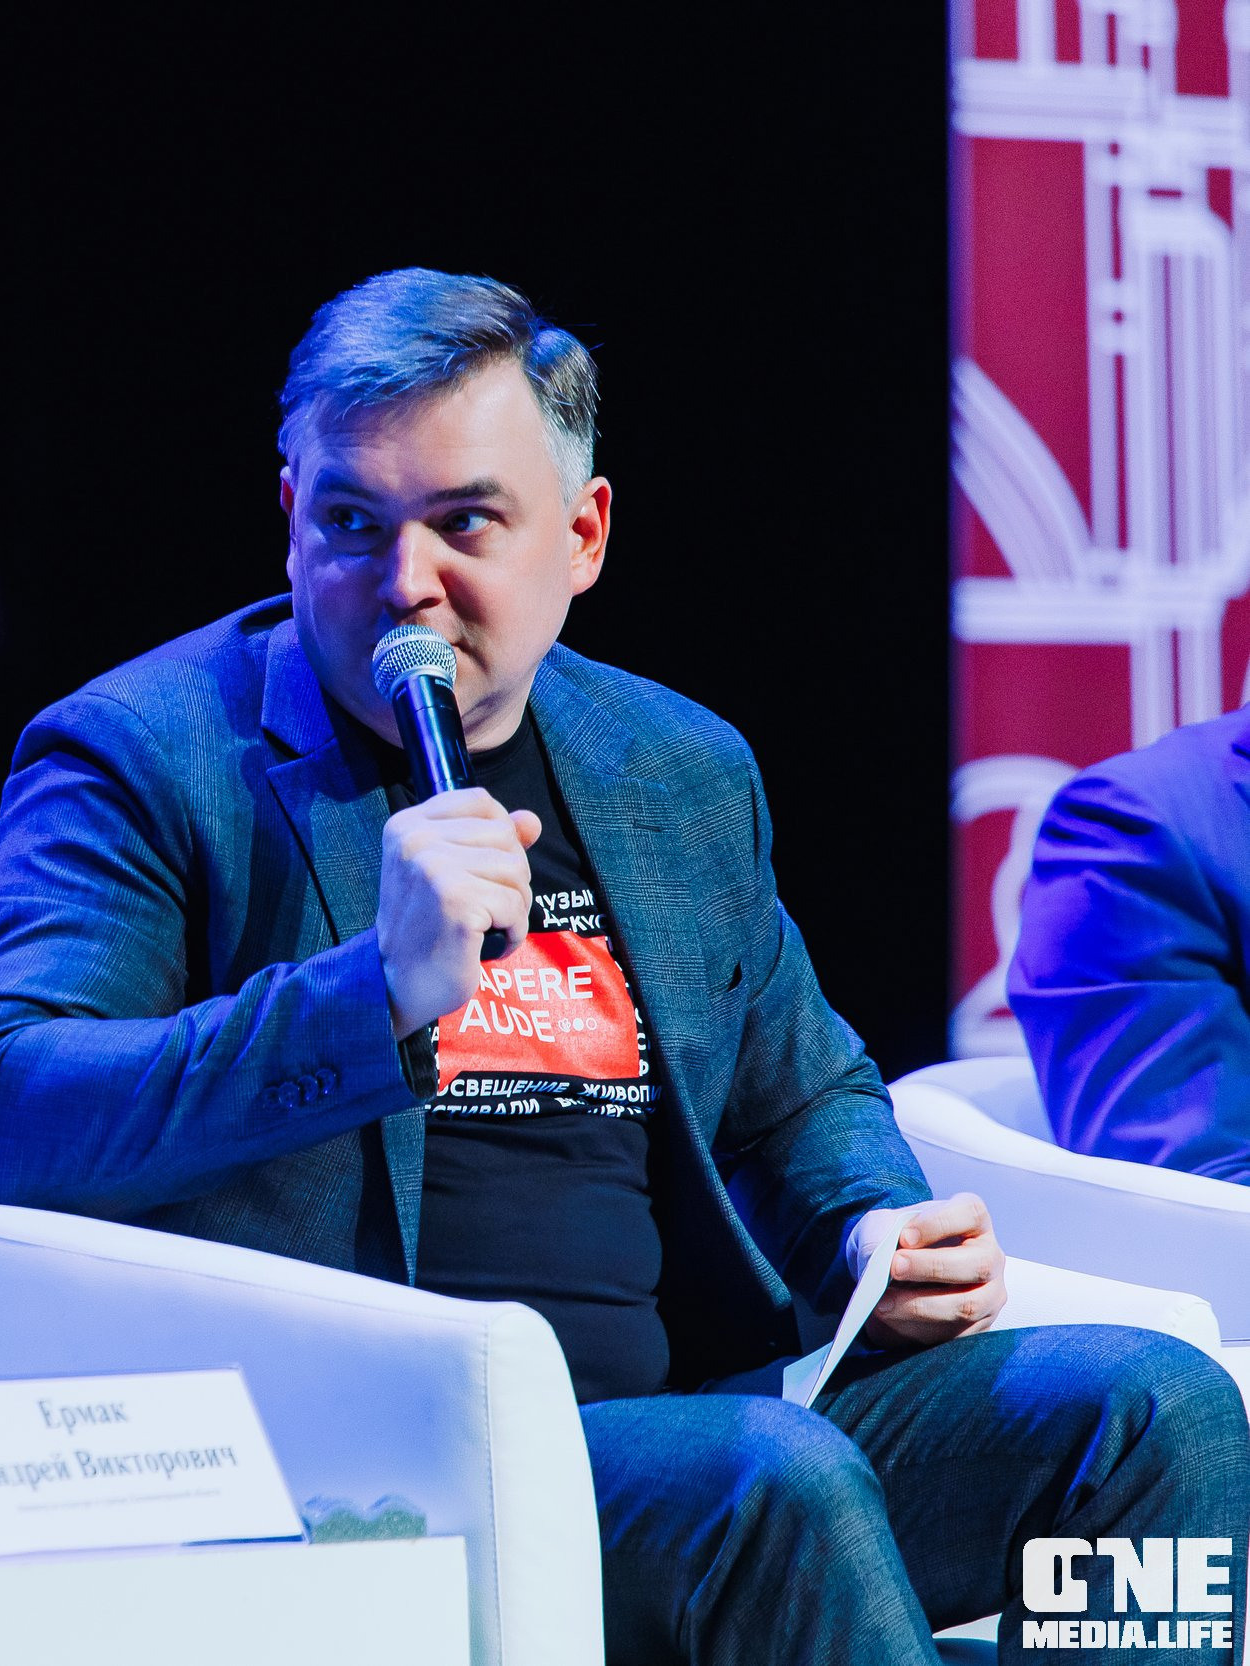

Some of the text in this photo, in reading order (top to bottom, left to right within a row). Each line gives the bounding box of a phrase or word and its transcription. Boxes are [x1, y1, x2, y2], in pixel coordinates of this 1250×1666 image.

[458, 999, 556, 1043] AUDE
[37, 1398, 130, 1435] Ермак
[74, 1444, 239, 1480] Викторович
